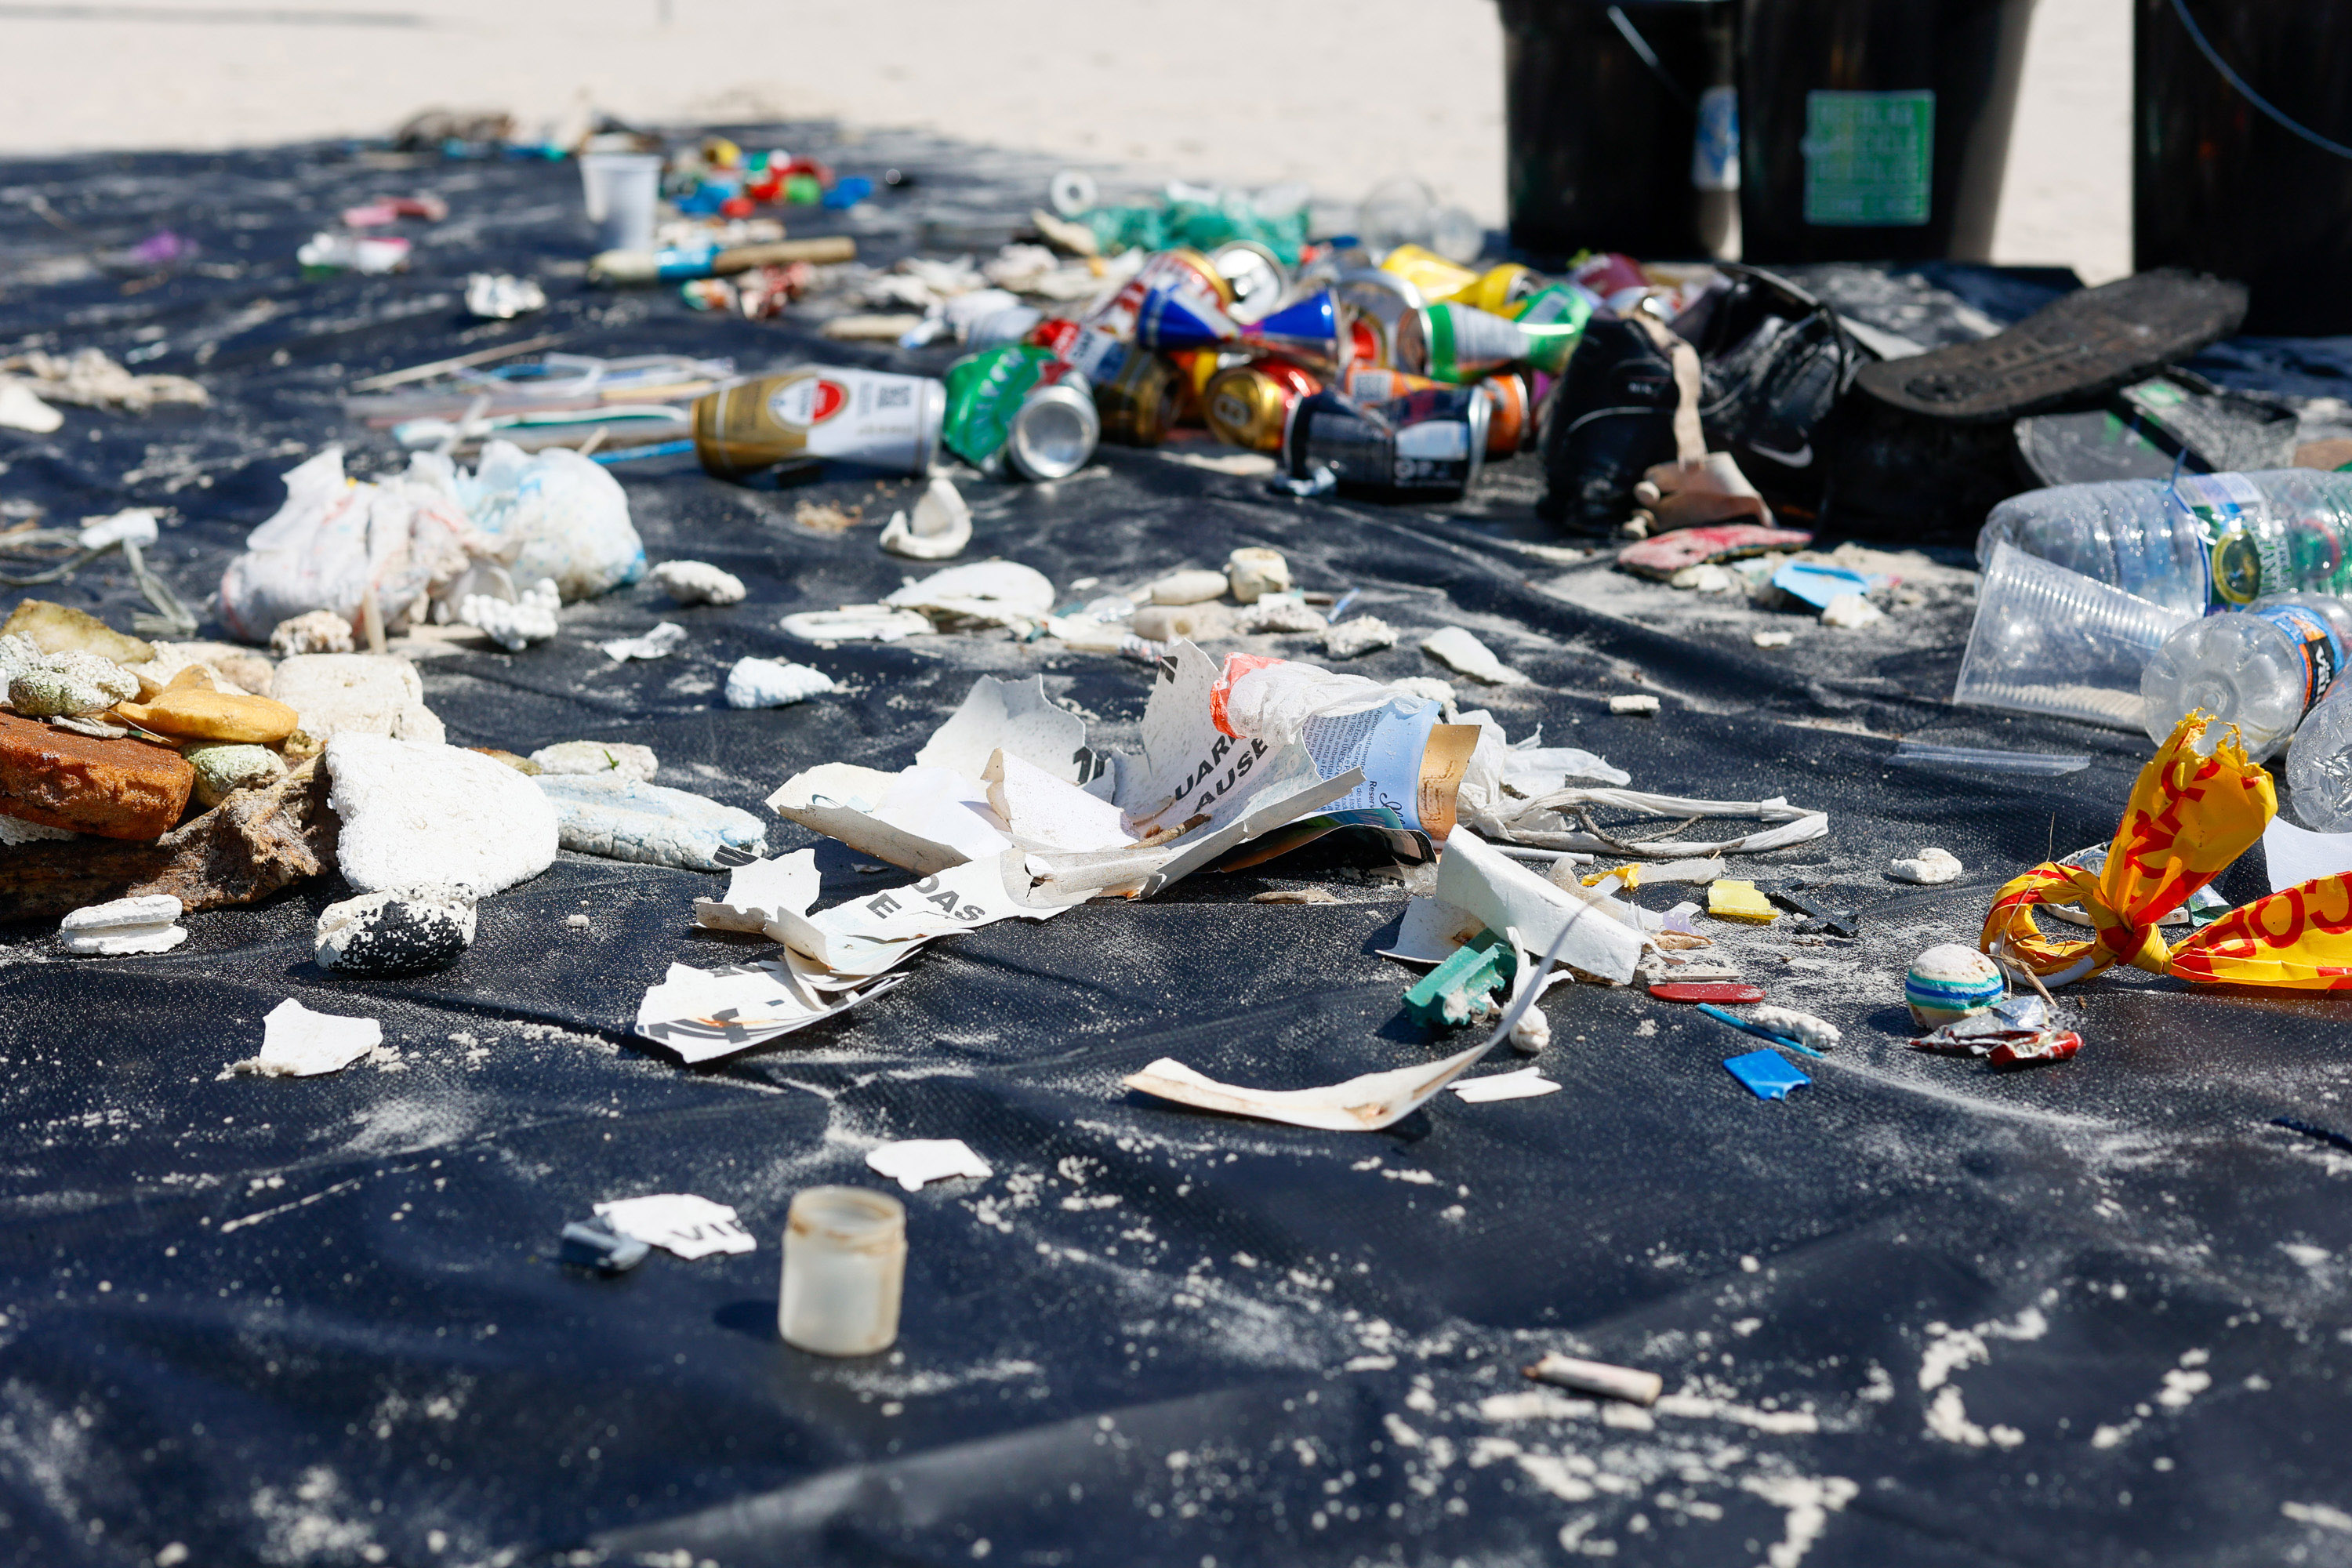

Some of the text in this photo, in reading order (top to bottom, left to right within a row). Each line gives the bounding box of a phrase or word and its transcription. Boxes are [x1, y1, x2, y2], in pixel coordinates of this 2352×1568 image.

[1315, 724, 1330, 762] paranaense
[1327, 740, 1341, 775] ambiental
[1335, 743, 1348, 771] UNESCO
[1359, 710, 1382, 770] Aproximadamente
[1175, 735, 1236, 800] UAR
[1193, 738, 1269, 814] AUSE
